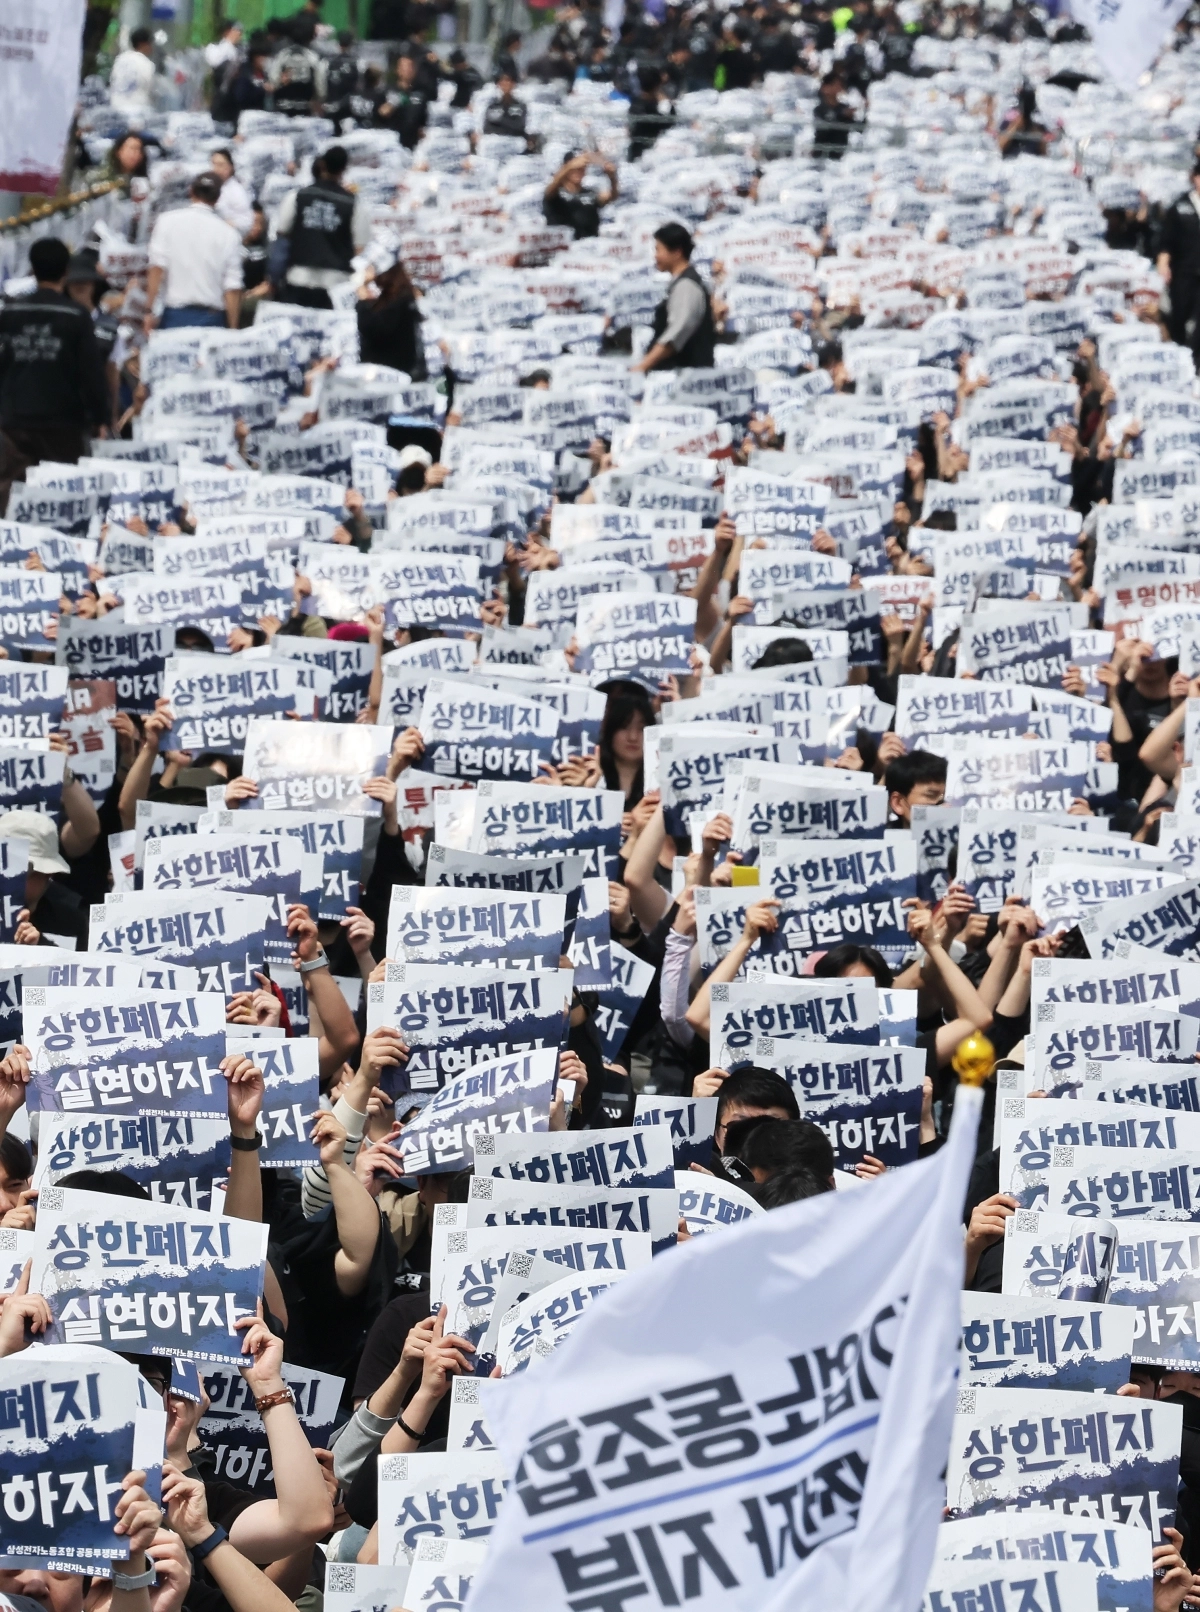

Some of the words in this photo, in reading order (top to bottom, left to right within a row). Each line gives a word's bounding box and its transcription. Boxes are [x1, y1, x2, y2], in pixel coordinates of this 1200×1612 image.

[172, 668, 279, 707] 상한폐지
[906, 689, 1013, 722] 상한폐지
[177, 712, 285, 750] 실현하
[431, 700, 541, 731] 상한폐지
[431, 745, 548, 779] 실현하자
[483, 795, 604, 837] 상한폐지
[748, 795, 869, 834] 상한폐지
[770, 846, 897, 898] 상한폐지
[96, 907, 227, 953] 상한폐지
[398, 899, 541, 947] 상한폐지
[782, 897, 913, 949] 실현하자
[37, 998, 200, 1051] 상한폐지
[394, 978, 541, 1032] 상한폐지
[720, 992, 857, 1048] 상한폐지
[1046, 1019, 1181, 1069] 상한폐지
[55, 1056, 225, 1111] 실현하자
[138, 1108, 188, 1118] 삼성전자노동조합
[49, 1116, 195, 1170] 상한폐지
[1014, 1117, 1178, 1170] 상한폐지
[1061, 1165, 1200, 1218] 상한폐
[47, 1220, 232, 1271] 상한폐지
[58, 1291, 257, 1344] 실현하자
[151, 1346, 208, 1361] 삼성전자노동조합
[209, 1352, 252, 1366] 공동투쟁본부
[963, 1408, 1154, 1481] 상한폐지
[7, 1544, 76, 1559] 삼성전자노동조합
[76, 1545, 128, 1560] 공동투쟁본부
[47, 1560, 111, 1578] 삼성전자노동조합
